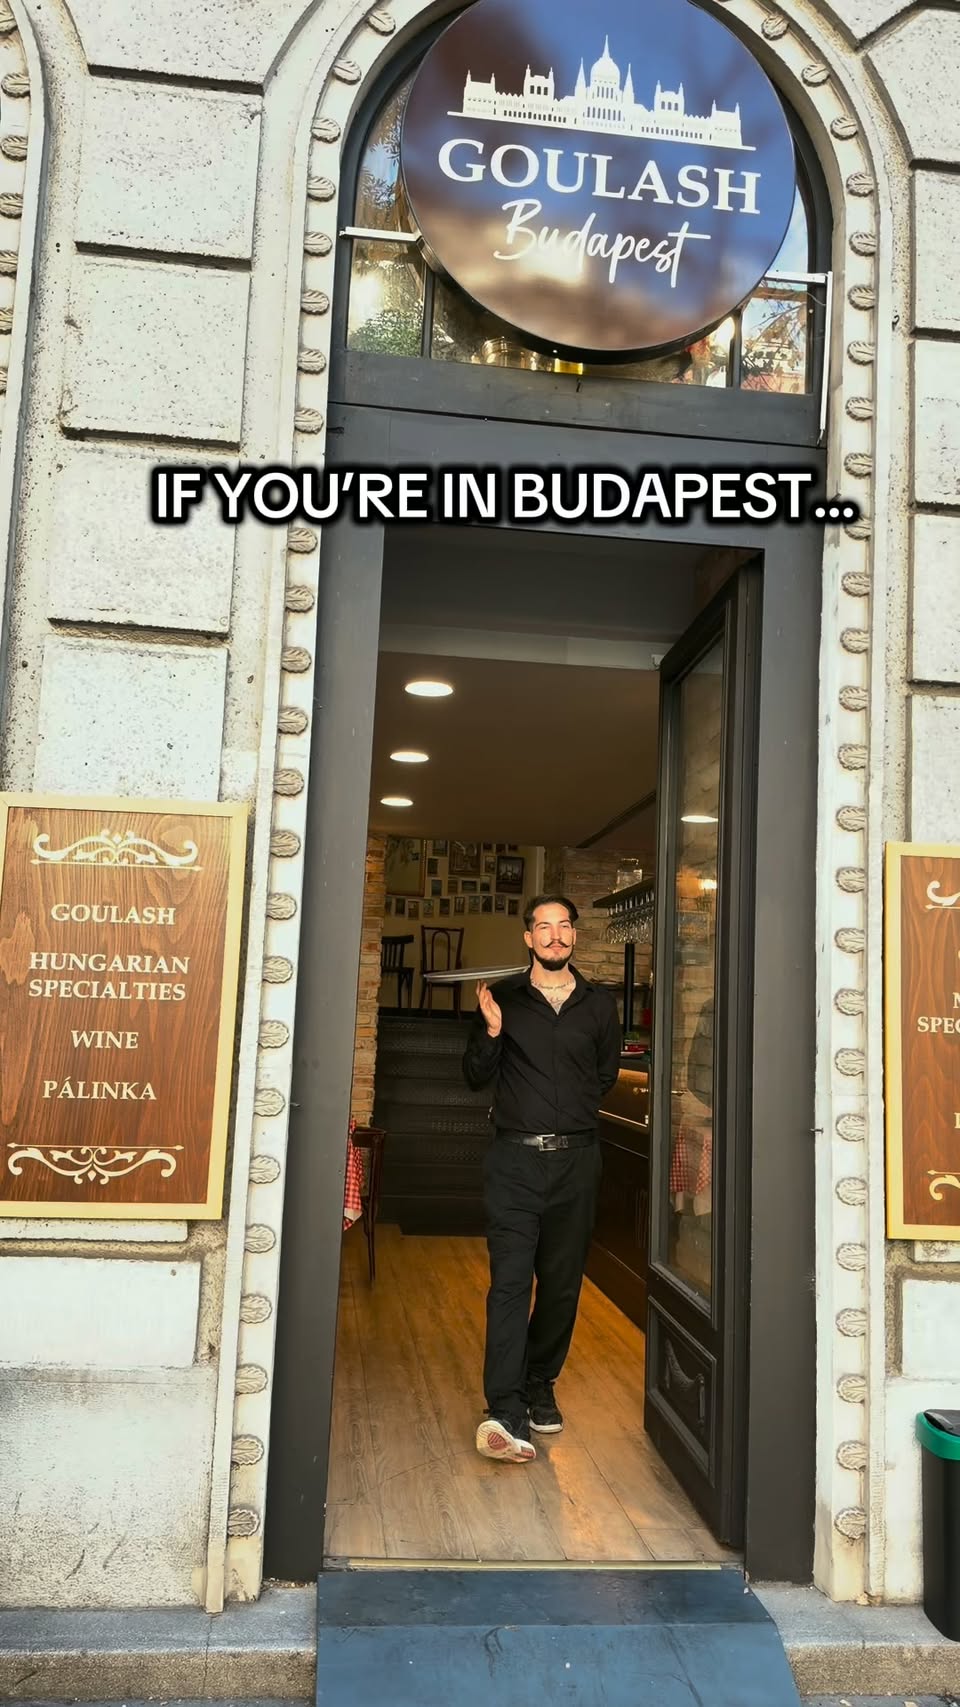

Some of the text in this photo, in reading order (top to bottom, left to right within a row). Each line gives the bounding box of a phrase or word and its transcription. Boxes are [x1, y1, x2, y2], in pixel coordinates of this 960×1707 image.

[438, 138, 762, 215] GOULASH
[493, 198, 711, 289] Budapest
[50, 903, 176, 926] GOULASH
[27, 951, 191, 975] HUNGARIAN
[27, 978, 187, 1001] SPECIALTIES
[70, 1030, 139, 1049] WINE
[42, 1076, 157, 1100] PÁLINKA
